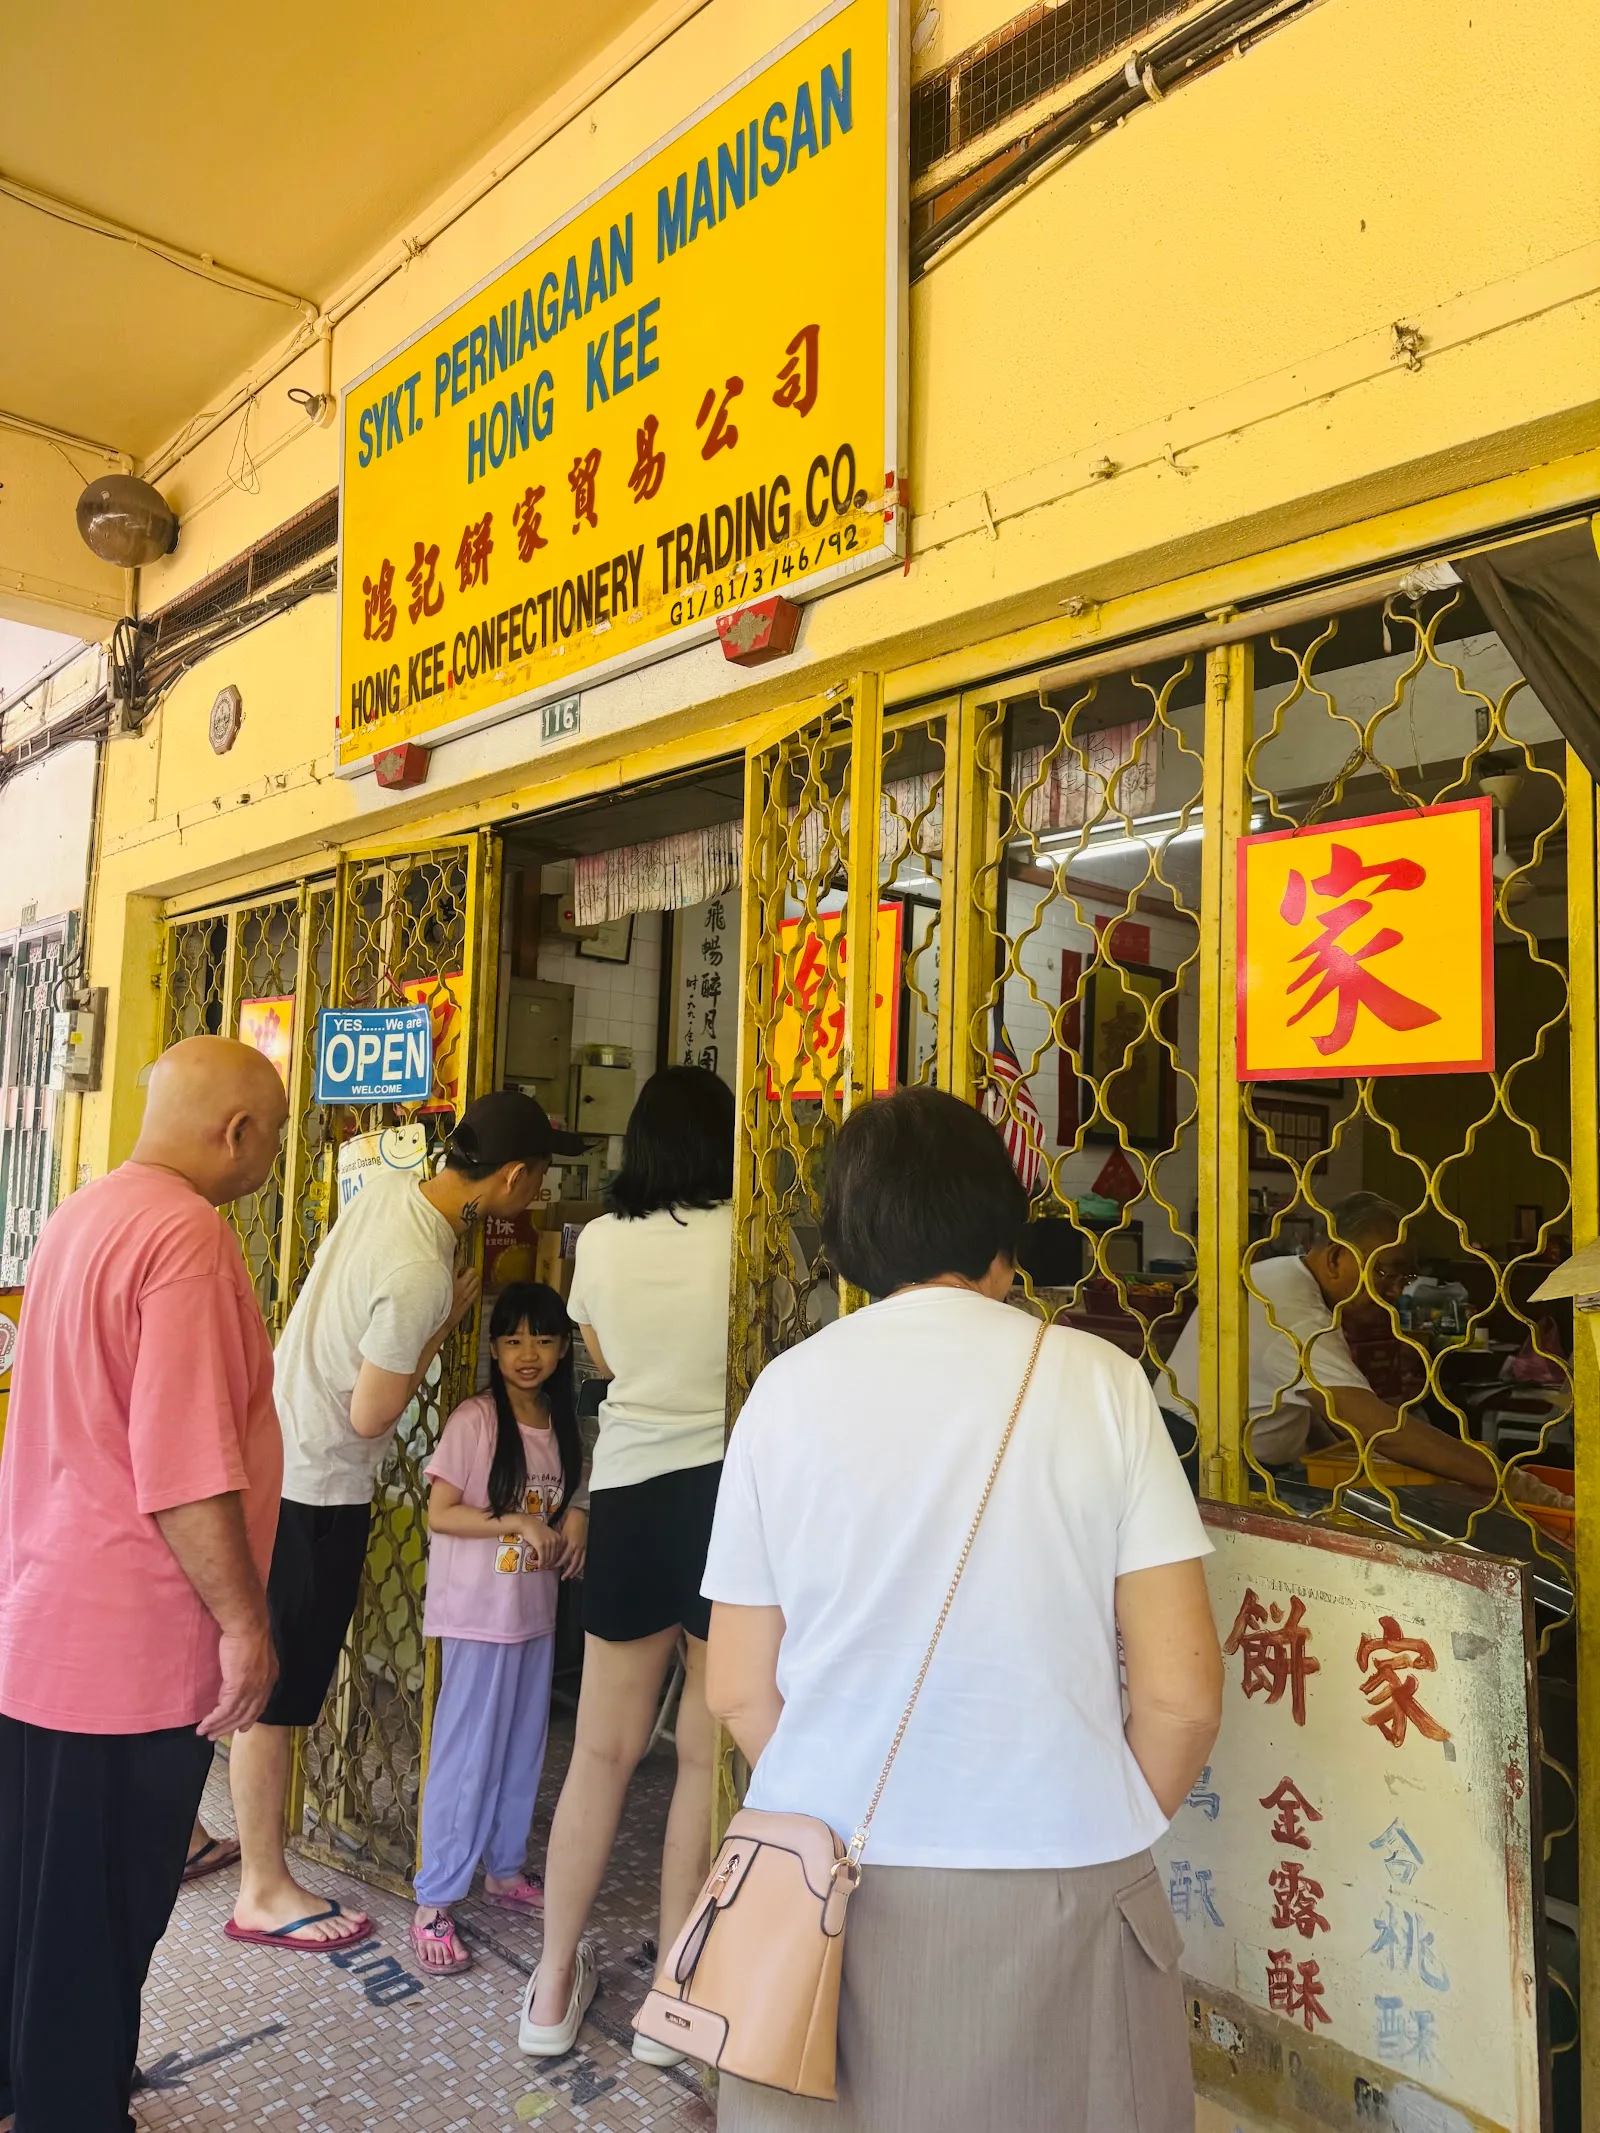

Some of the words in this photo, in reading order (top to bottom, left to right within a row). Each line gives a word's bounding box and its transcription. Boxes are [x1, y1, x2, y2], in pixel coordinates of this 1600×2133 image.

[358, 371, 423, 469] SYKT.
[434, 211, 633, 418] PERNIAGAAN
[657, 48, 853, 264] MANISAN
[467, 369, 554, 484] HONG
[586, 297, 661, 412] KEE
[351, 663, 401, 729] HONG
[407, 640, 446, 706] KEE
[452, 544, 645, 685] CONFECTIONERY
[656, 474, 791, 595] TRADING
[805, 443, 868, 527] CO.
[544, 701, 575, 737] 116
[1280, 843, 1442, 1056] 家
[325, 1030, 425, 1082] OPEN
[406, 1017, 422, 1029] are
[351, 1084, 403, 1095] WELCOME
[357, 1155, 382, 1169] Datang
[1258, 1775, 1333, 2032] 金露酥
